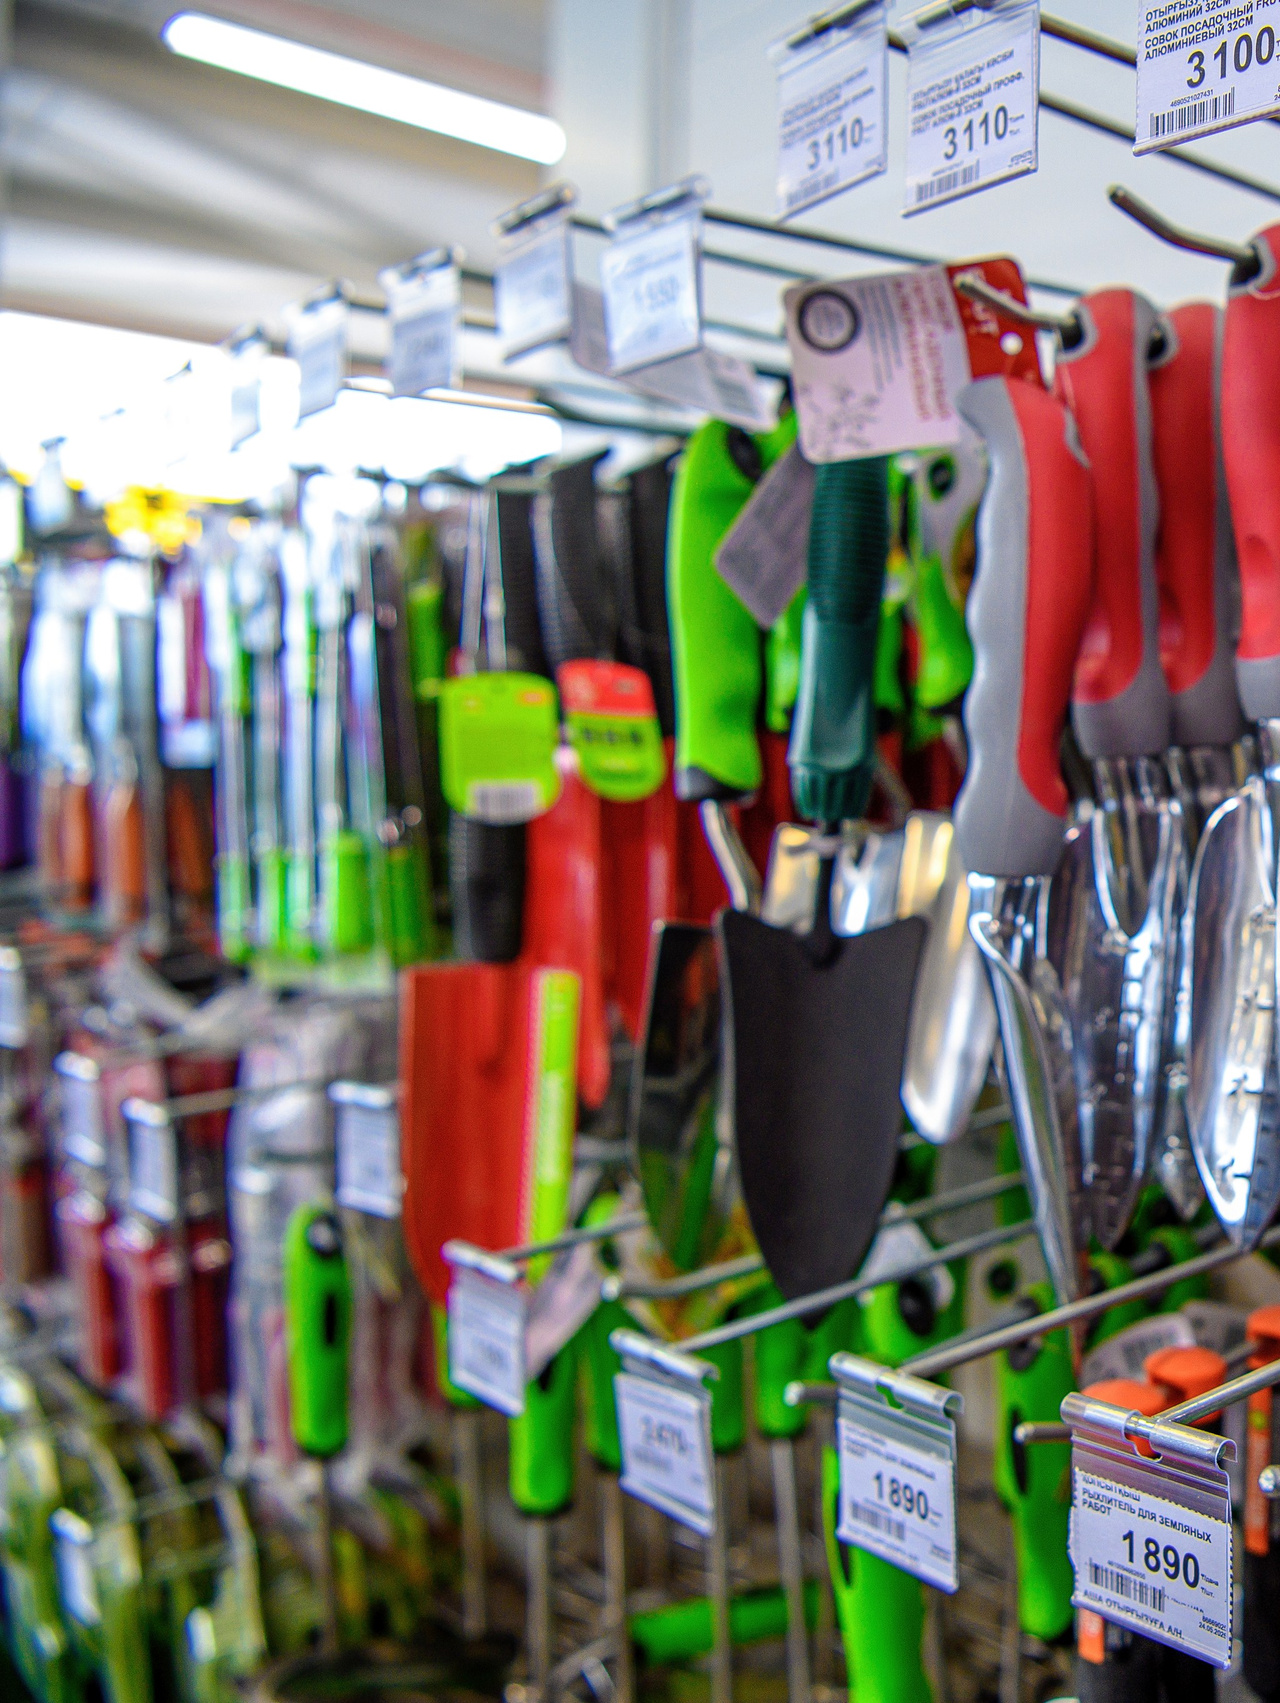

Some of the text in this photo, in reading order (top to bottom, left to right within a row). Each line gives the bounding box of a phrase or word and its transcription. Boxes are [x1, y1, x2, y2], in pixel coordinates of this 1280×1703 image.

[1144, 15, 1254, 61] АЛЮМИНИЕВЫЙ 32СМ
[1145, 4, 1203, 34] АЛЮМИНИЙ
[1145, 29, 1178, 49] СОВОК
[1181, 2, 1253, 36] ПОСАДОЧНЫЙ
[944, 105, 1008, 160] 3110
[873, 1471, 929, 1520] 1890
[1082, 1498, 1112, 1516] РАБОТ
[1082, 1487, 1212, 1544] РЫХЛИТЕЛЬ ДЛЯ ЗЕМЛЯНЫХ
[1122, 1529, 1200, 1589] 1890
